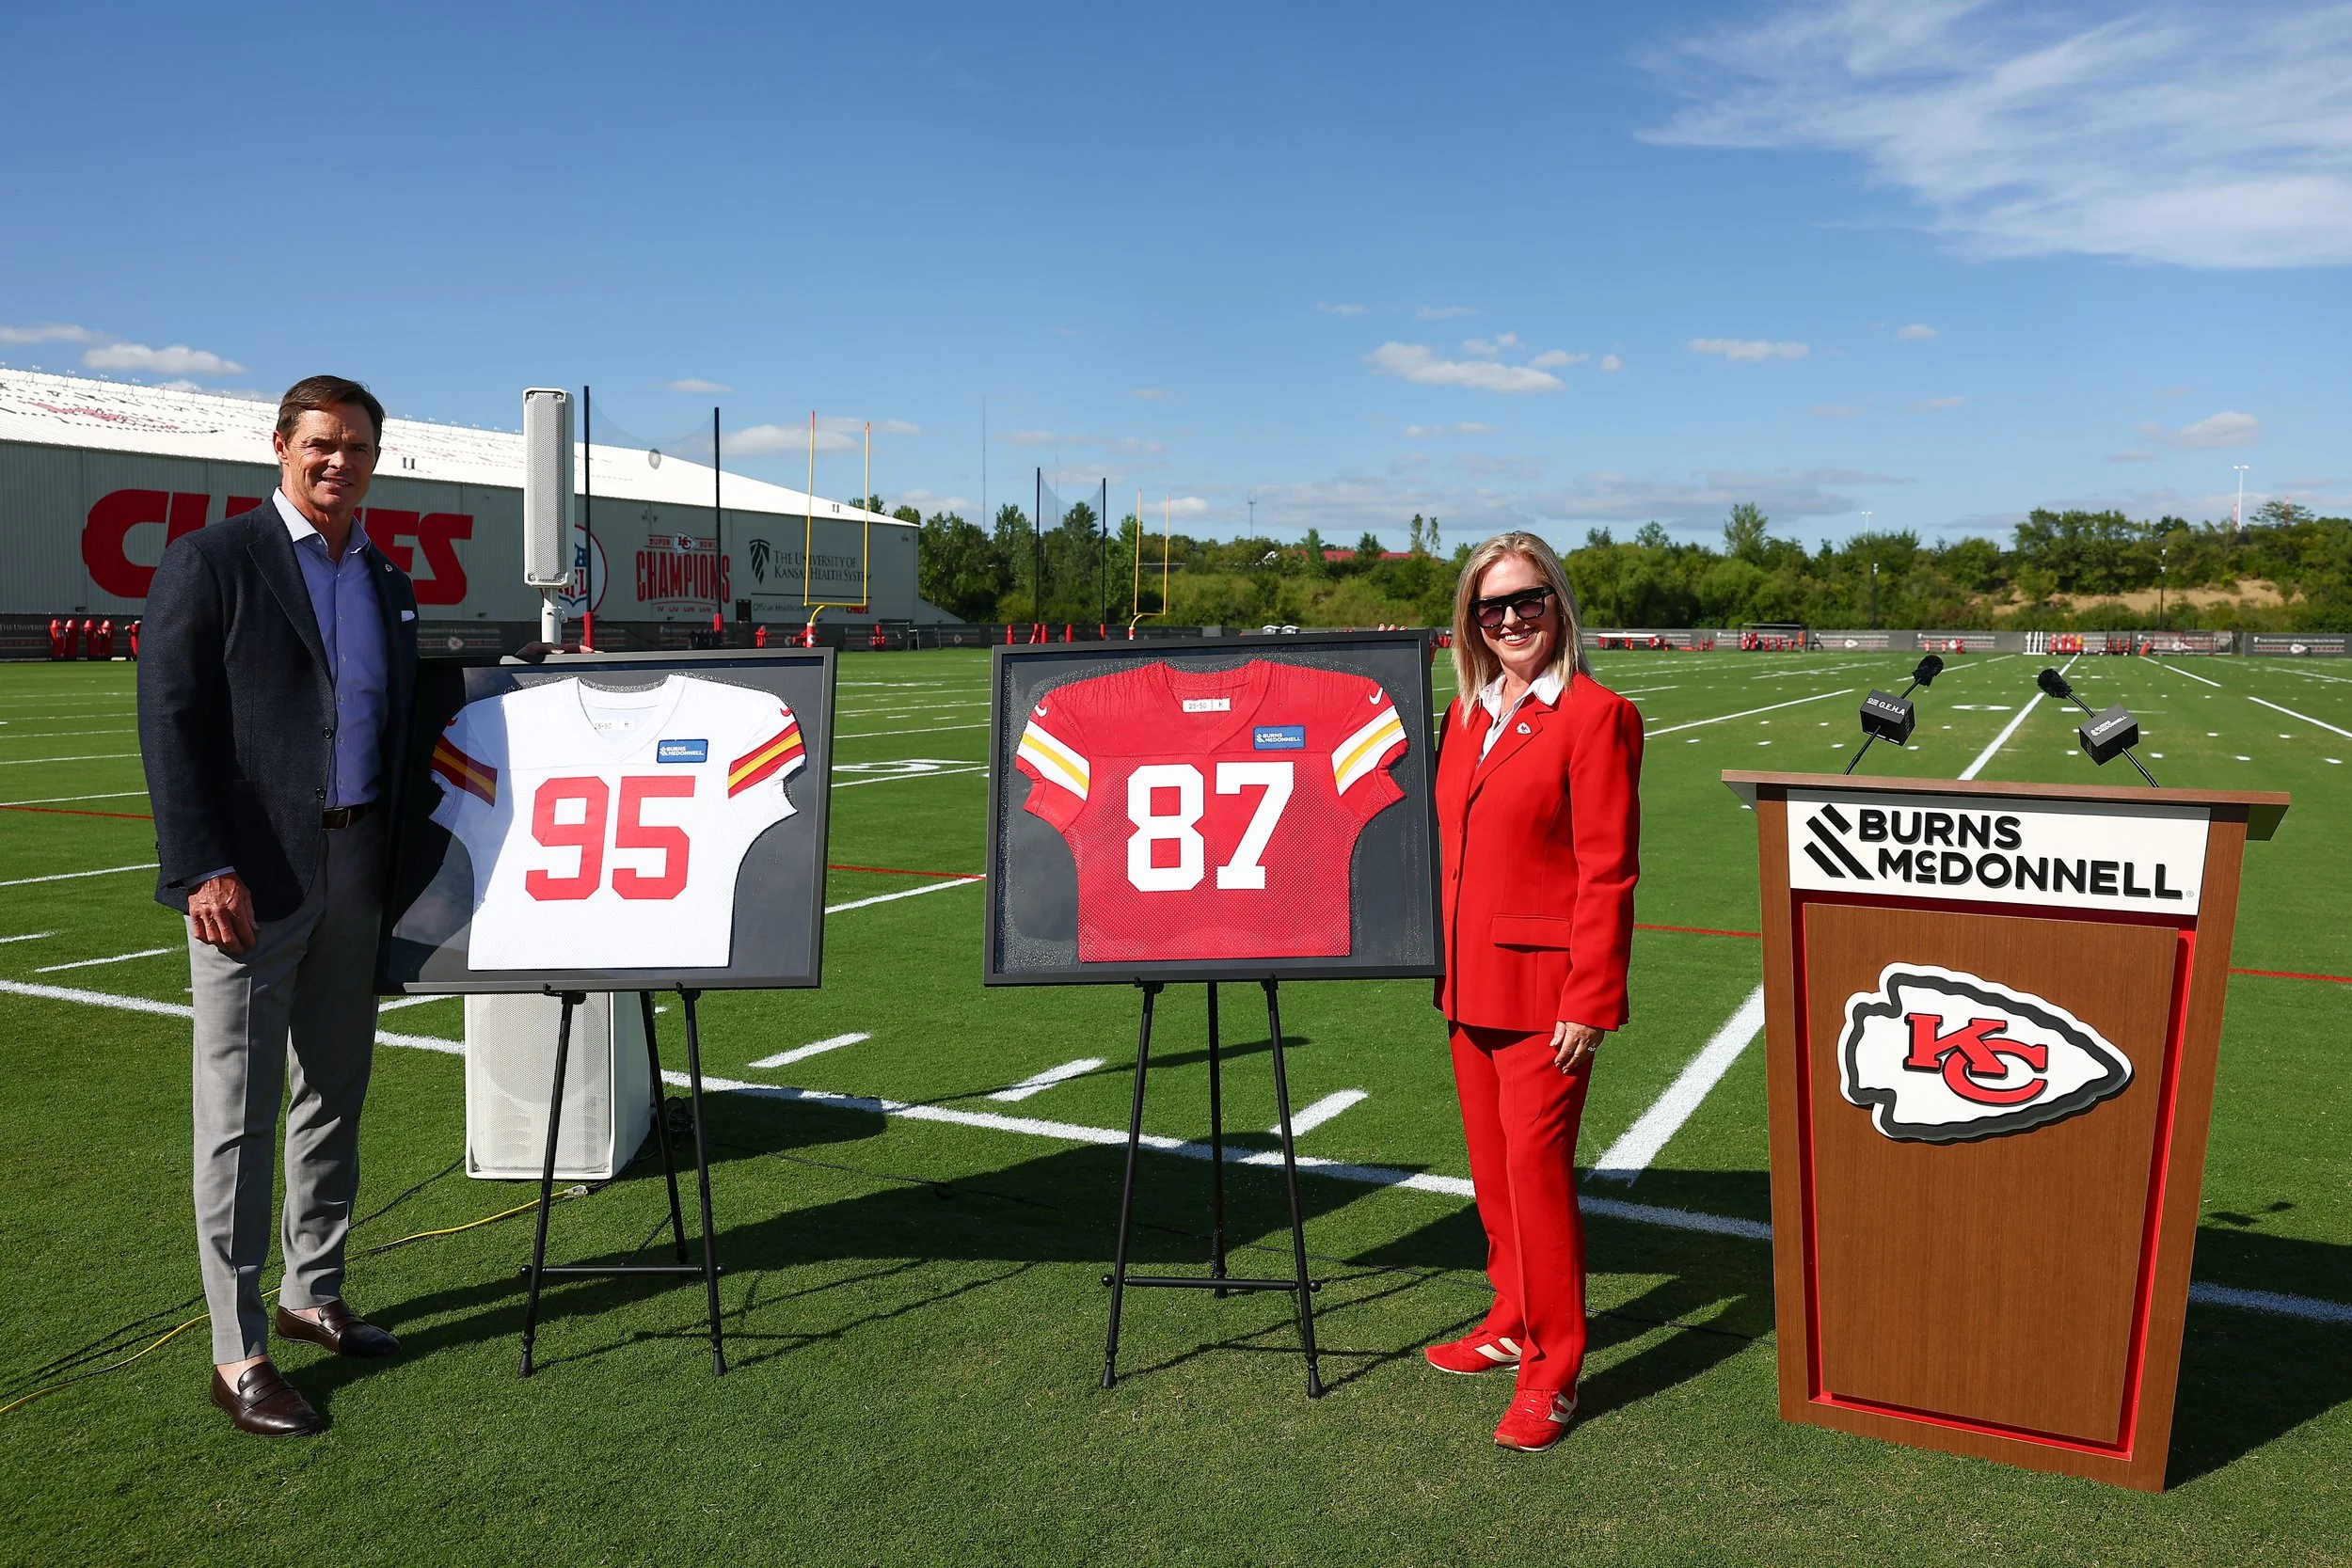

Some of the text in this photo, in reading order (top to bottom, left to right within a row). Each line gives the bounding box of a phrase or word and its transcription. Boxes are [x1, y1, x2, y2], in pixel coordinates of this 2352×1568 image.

[636, 550, 730, 603] CHAMPIONS
[773, 550, 792, 564] THE
[847, 557, 857, 568] OF
[774, 565, 807, 579] KANSA
[810, 567, 844, 581] HEALTH
[525, 775, 696, 901] 95
[1126, 760, 1295, 894] 87
[1859, 809, 2022, 850] BURNS
[1902, 1012, 2049, 1107] KC
